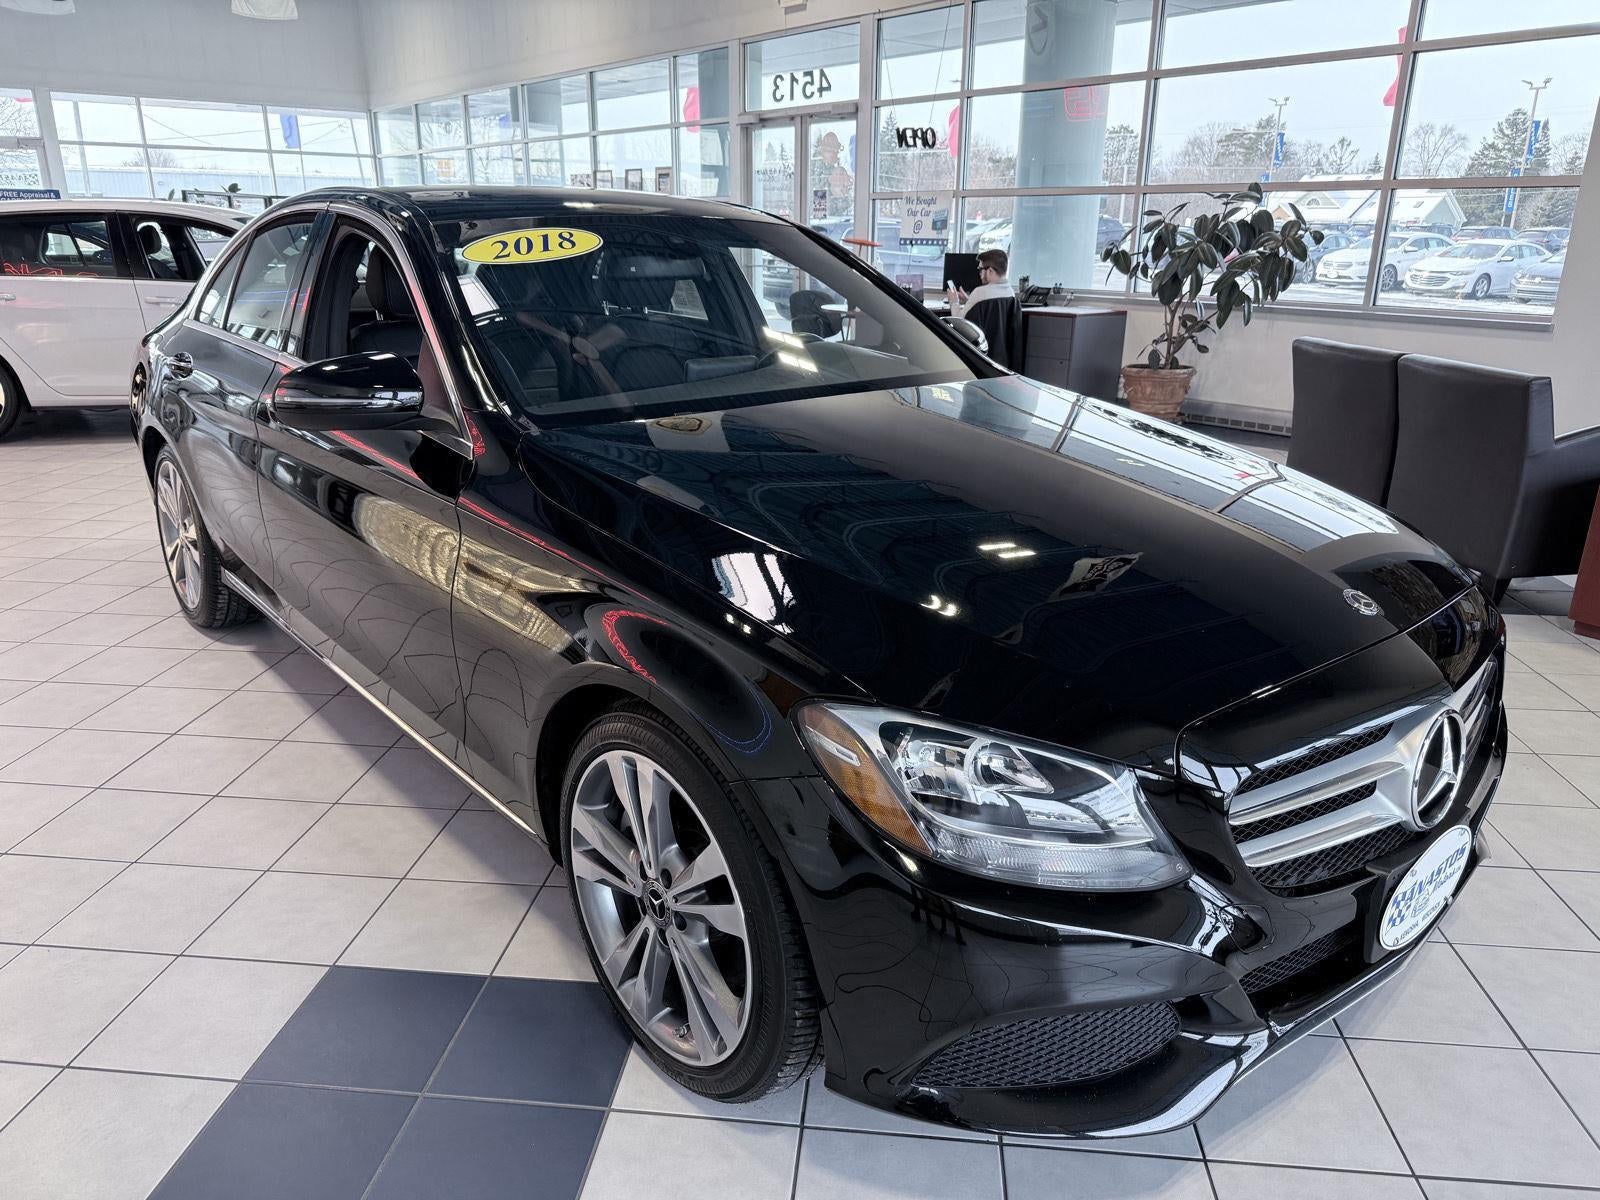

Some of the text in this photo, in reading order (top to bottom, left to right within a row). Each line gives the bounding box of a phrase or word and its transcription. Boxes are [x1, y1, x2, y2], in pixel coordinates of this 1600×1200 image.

[19, 191, 50, 199] Appraisal
[905, 196, 937, 206] We Bought
[907, 208, 920, 217] Our
[920, 208, 932, 217] Car
[490, 231, 577, 260] 2018
